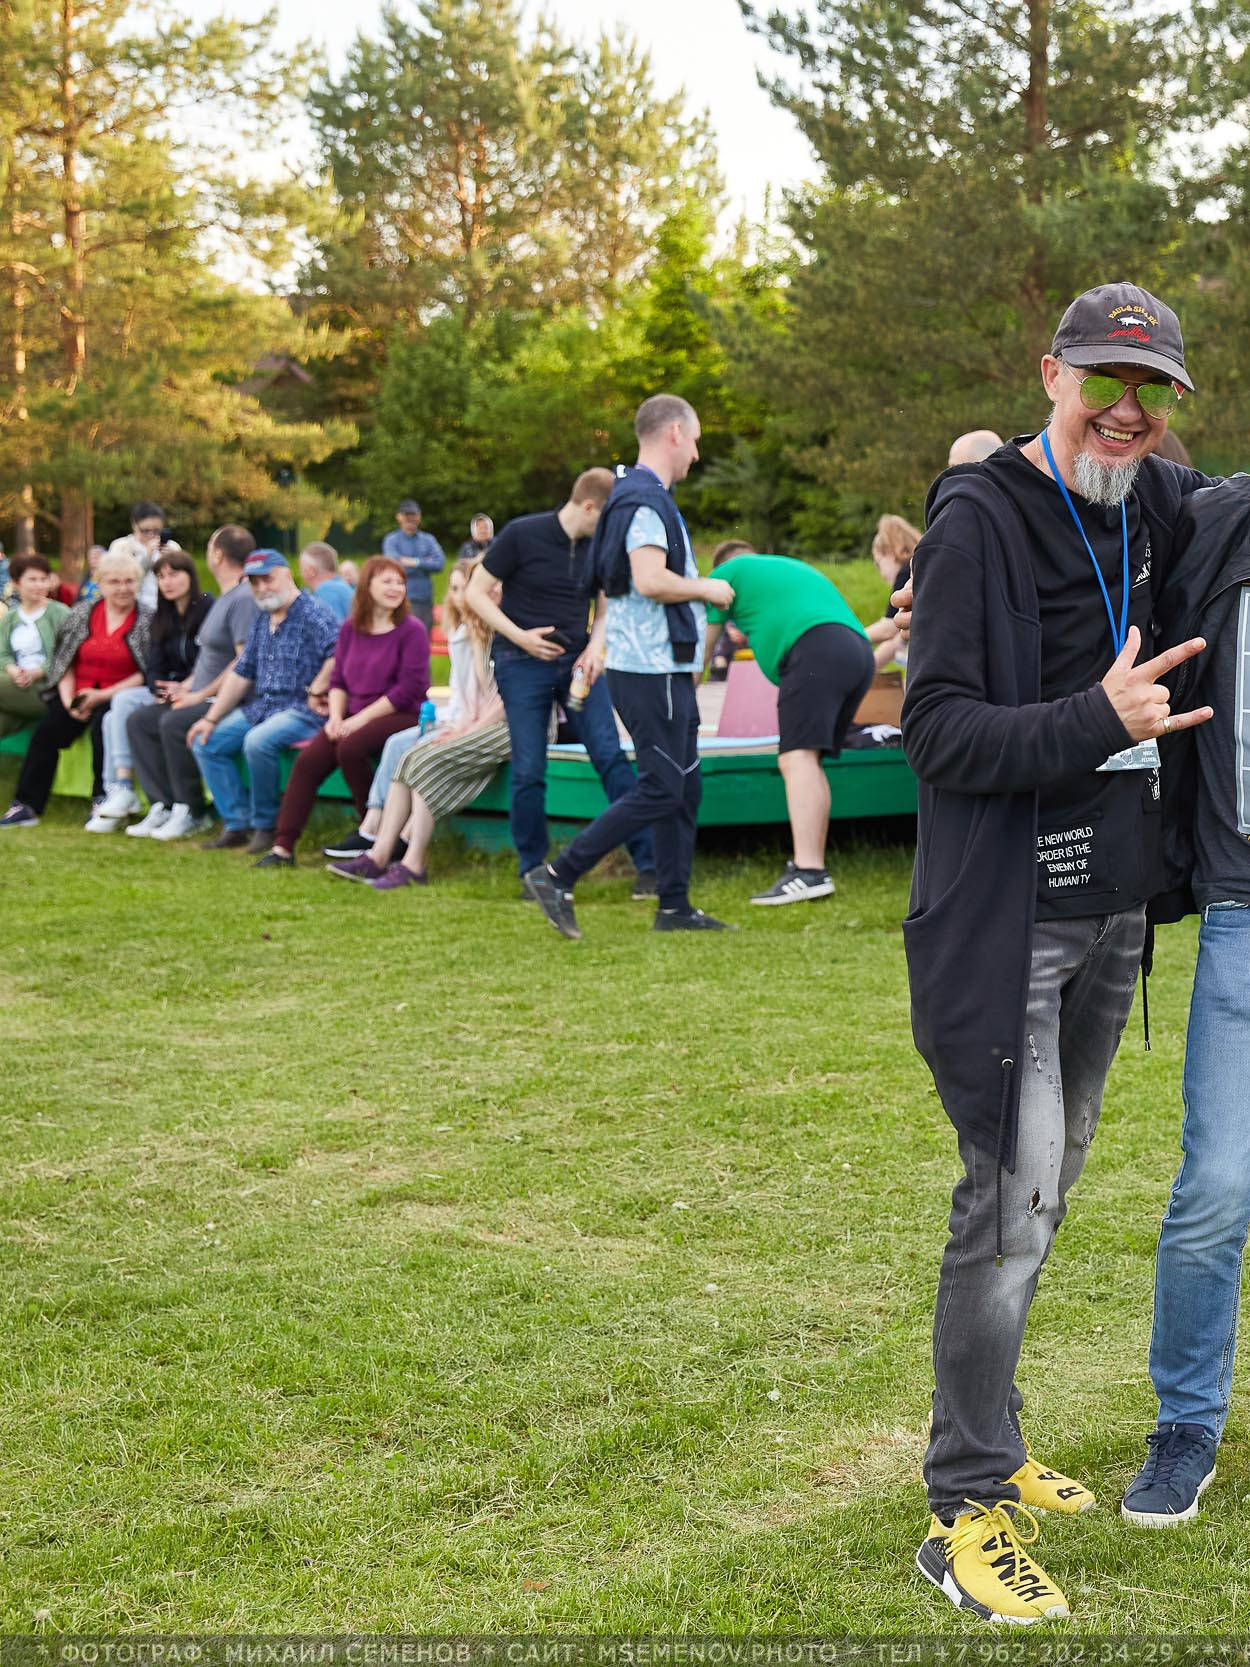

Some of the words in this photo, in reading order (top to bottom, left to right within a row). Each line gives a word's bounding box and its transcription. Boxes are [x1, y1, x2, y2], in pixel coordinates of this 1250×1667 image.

[1045, 832, 1064, 846] NEW
[1063, 826, 1094, 842] WORLD
[1065, 846, 1074, 858] IS
[1073, 842, 1092, 855] THE
[1046, 861, 1076, 873] ENEMY
[1076, 859, 1089, 870] OF
